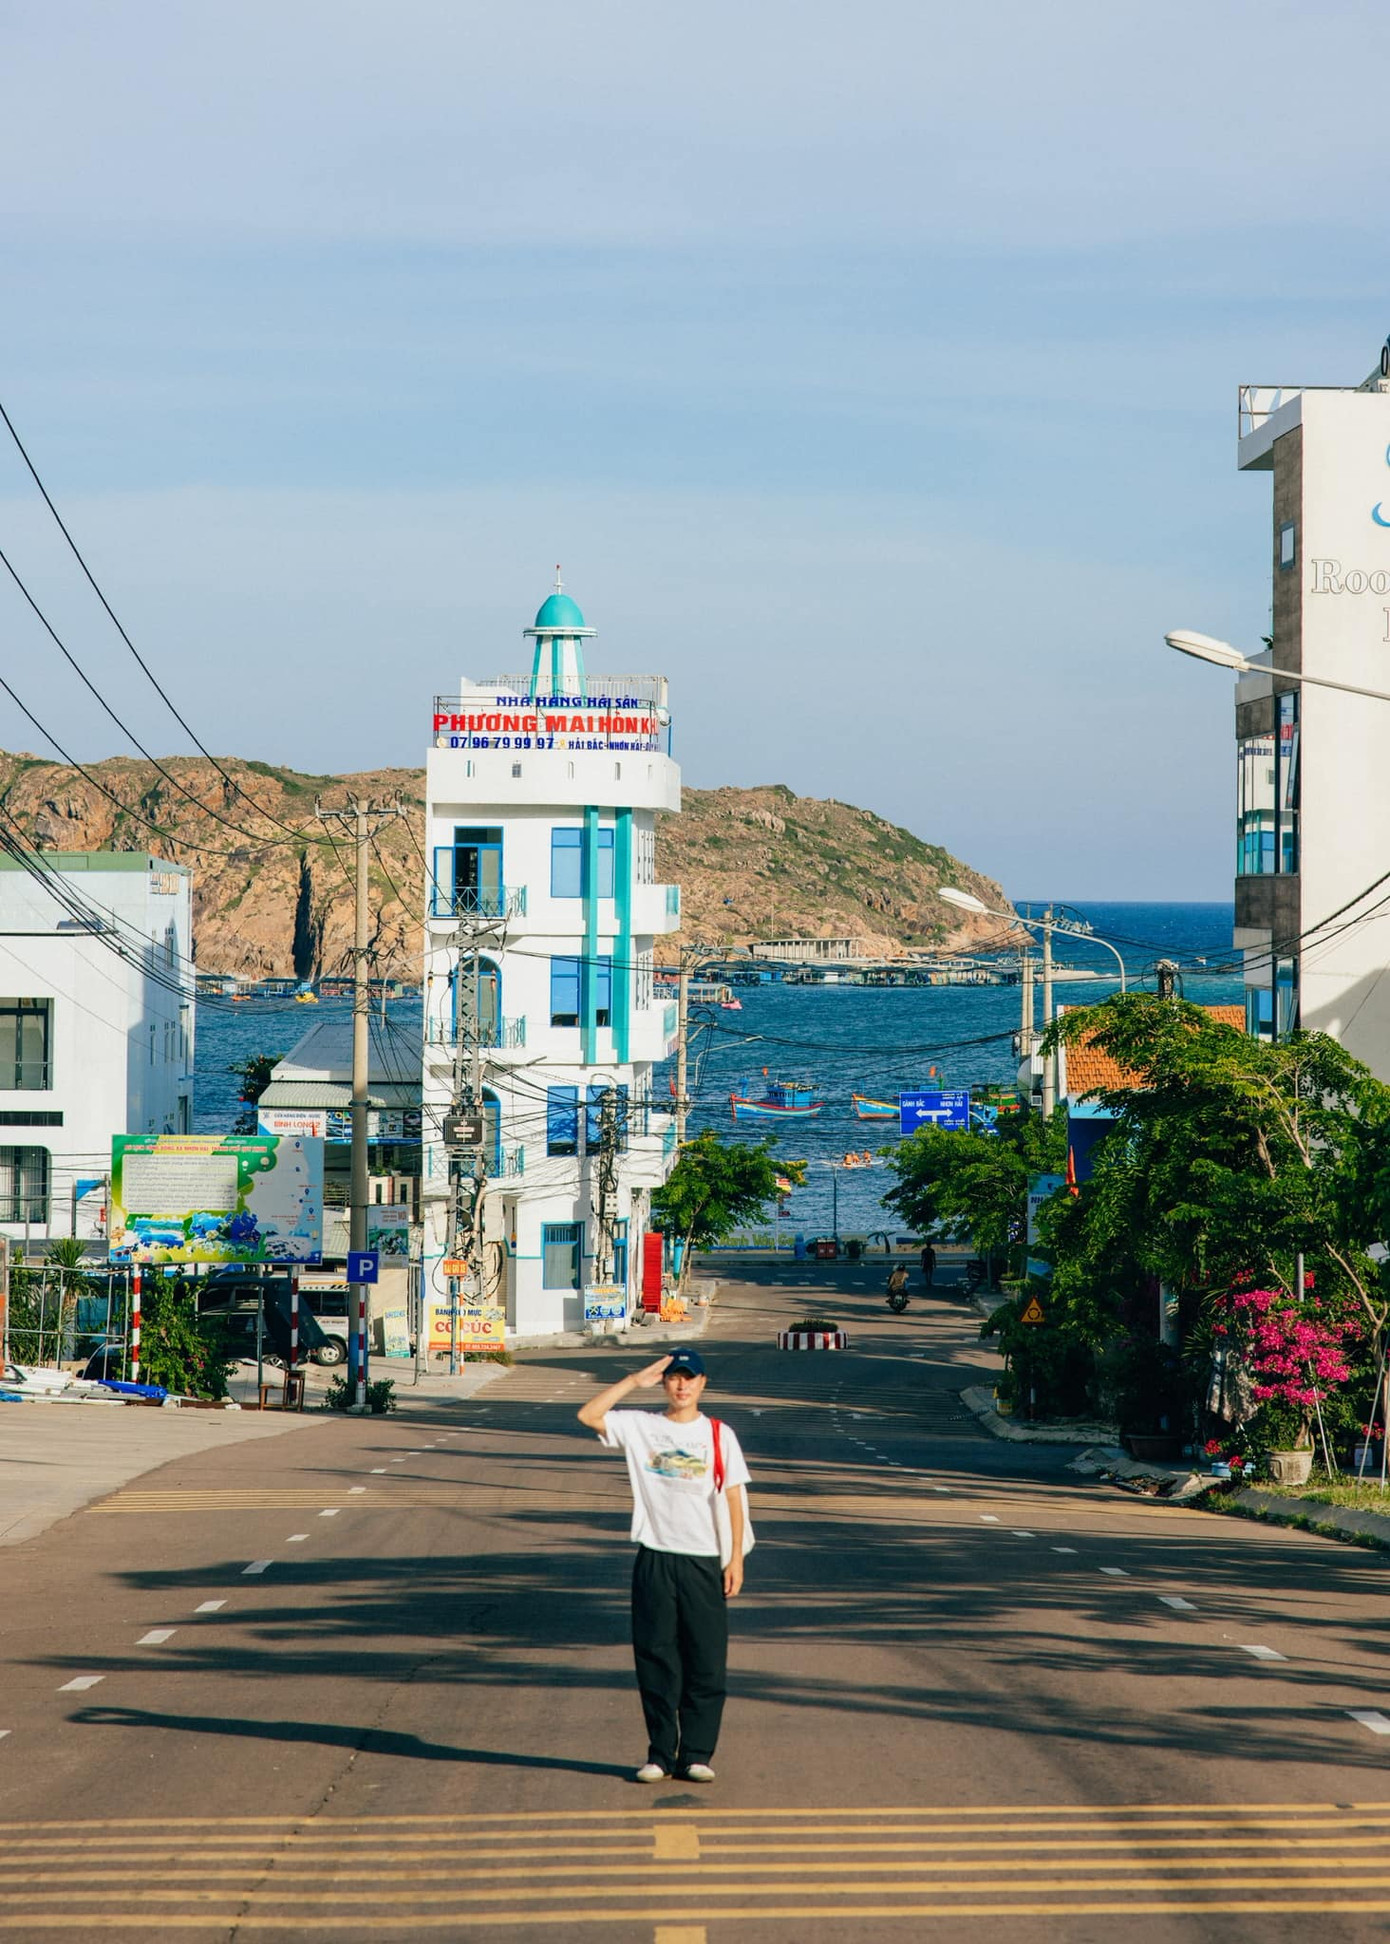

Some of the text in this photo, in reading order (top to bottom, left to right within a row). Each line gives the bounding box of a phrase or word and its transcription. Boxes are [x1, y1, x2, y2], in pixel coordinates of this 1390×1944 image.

[433, 713, 537, 732] PHƯƠNG
[546, 715, 593, 732] MAI
[450, 736, 554, 750] 07 96 79 99 97
[359, 1259, 374, 1277] P
